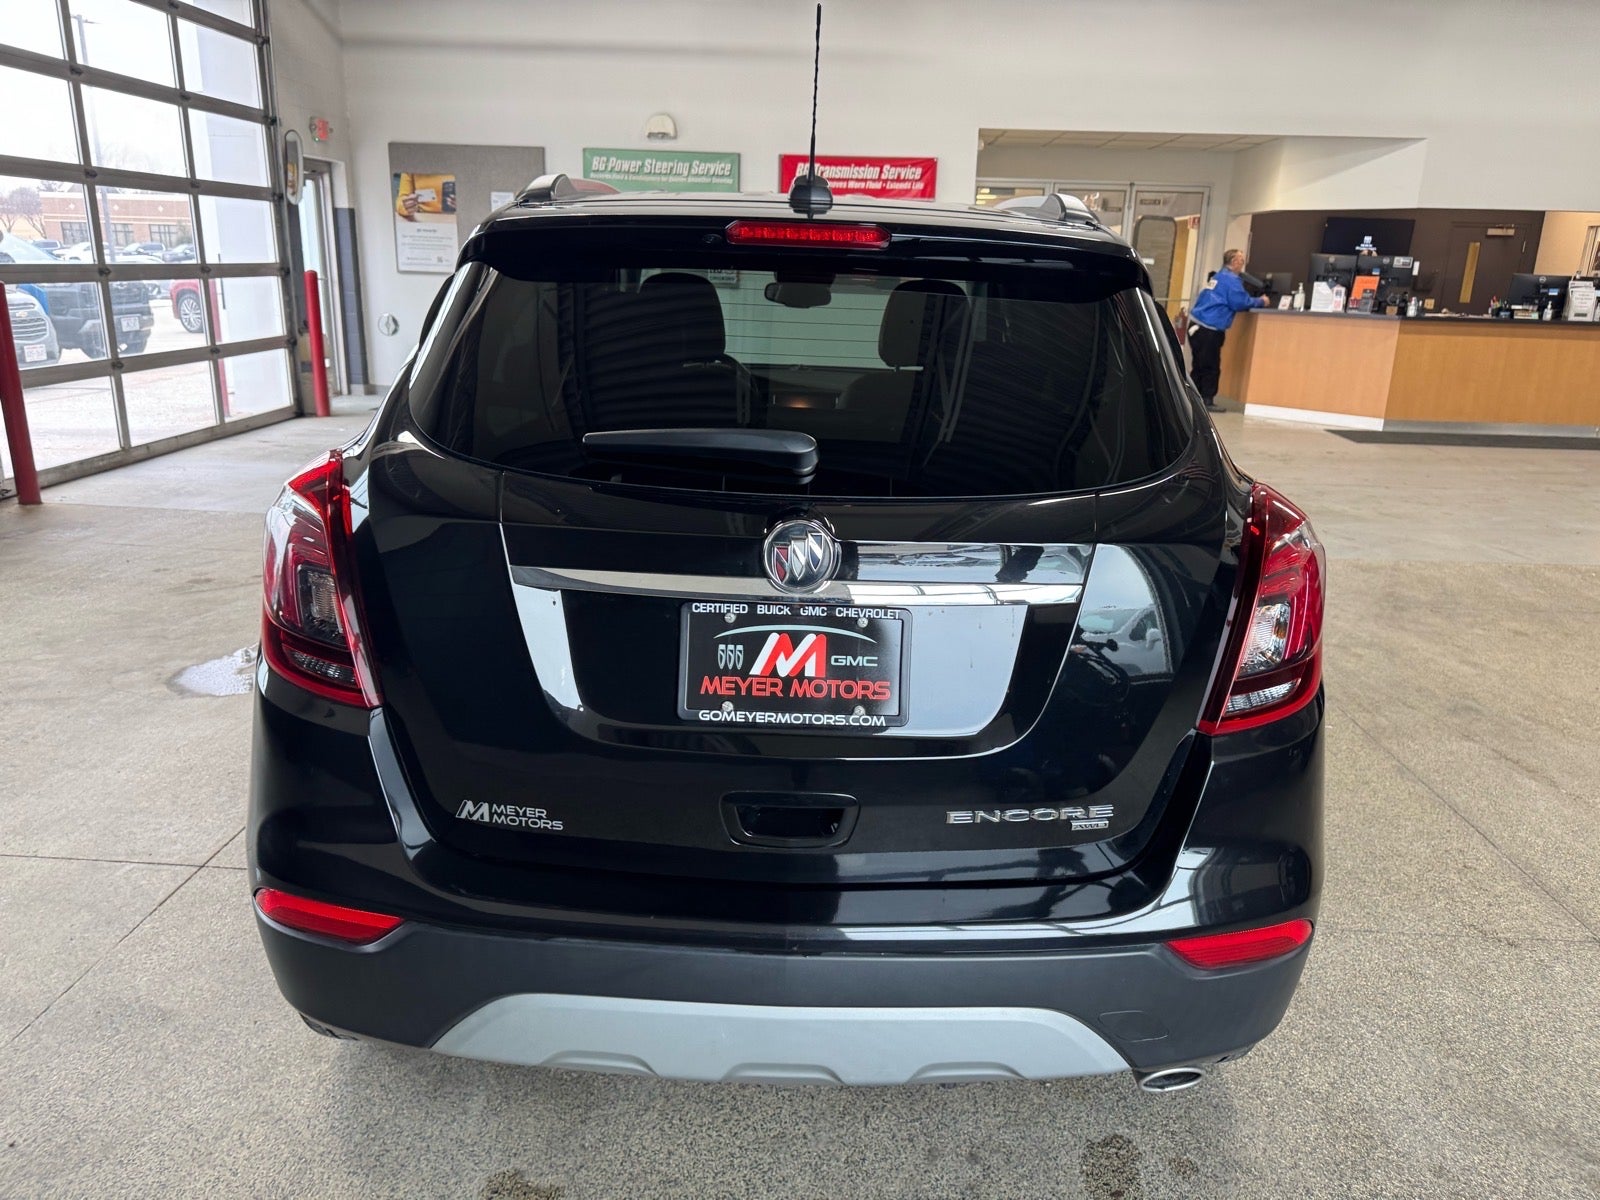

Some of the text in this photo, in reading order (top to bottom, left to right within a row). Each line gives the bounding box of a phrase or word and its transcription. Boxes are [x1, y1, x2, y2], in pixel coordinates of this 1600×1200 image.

[592, 156, 732, 176] BG Power Steering Service
[814, 162, 880, 180] Transmission
[881, 165, 922, 180] Service
[692, 602, 901, 620] CERTIFIED BUICK GMC CHEVROLET
[830, 655, 879, 667] GMC
[700, 675, 892, 700] MEYER MOTORS
[698, 709, 887, 727] GOMEYERMOTORS.COM
[491, 803, 548, 819] MEYER
[946, 804, 1115, 824] ENCORE
[492, 813, 564, 831] MOTORS
